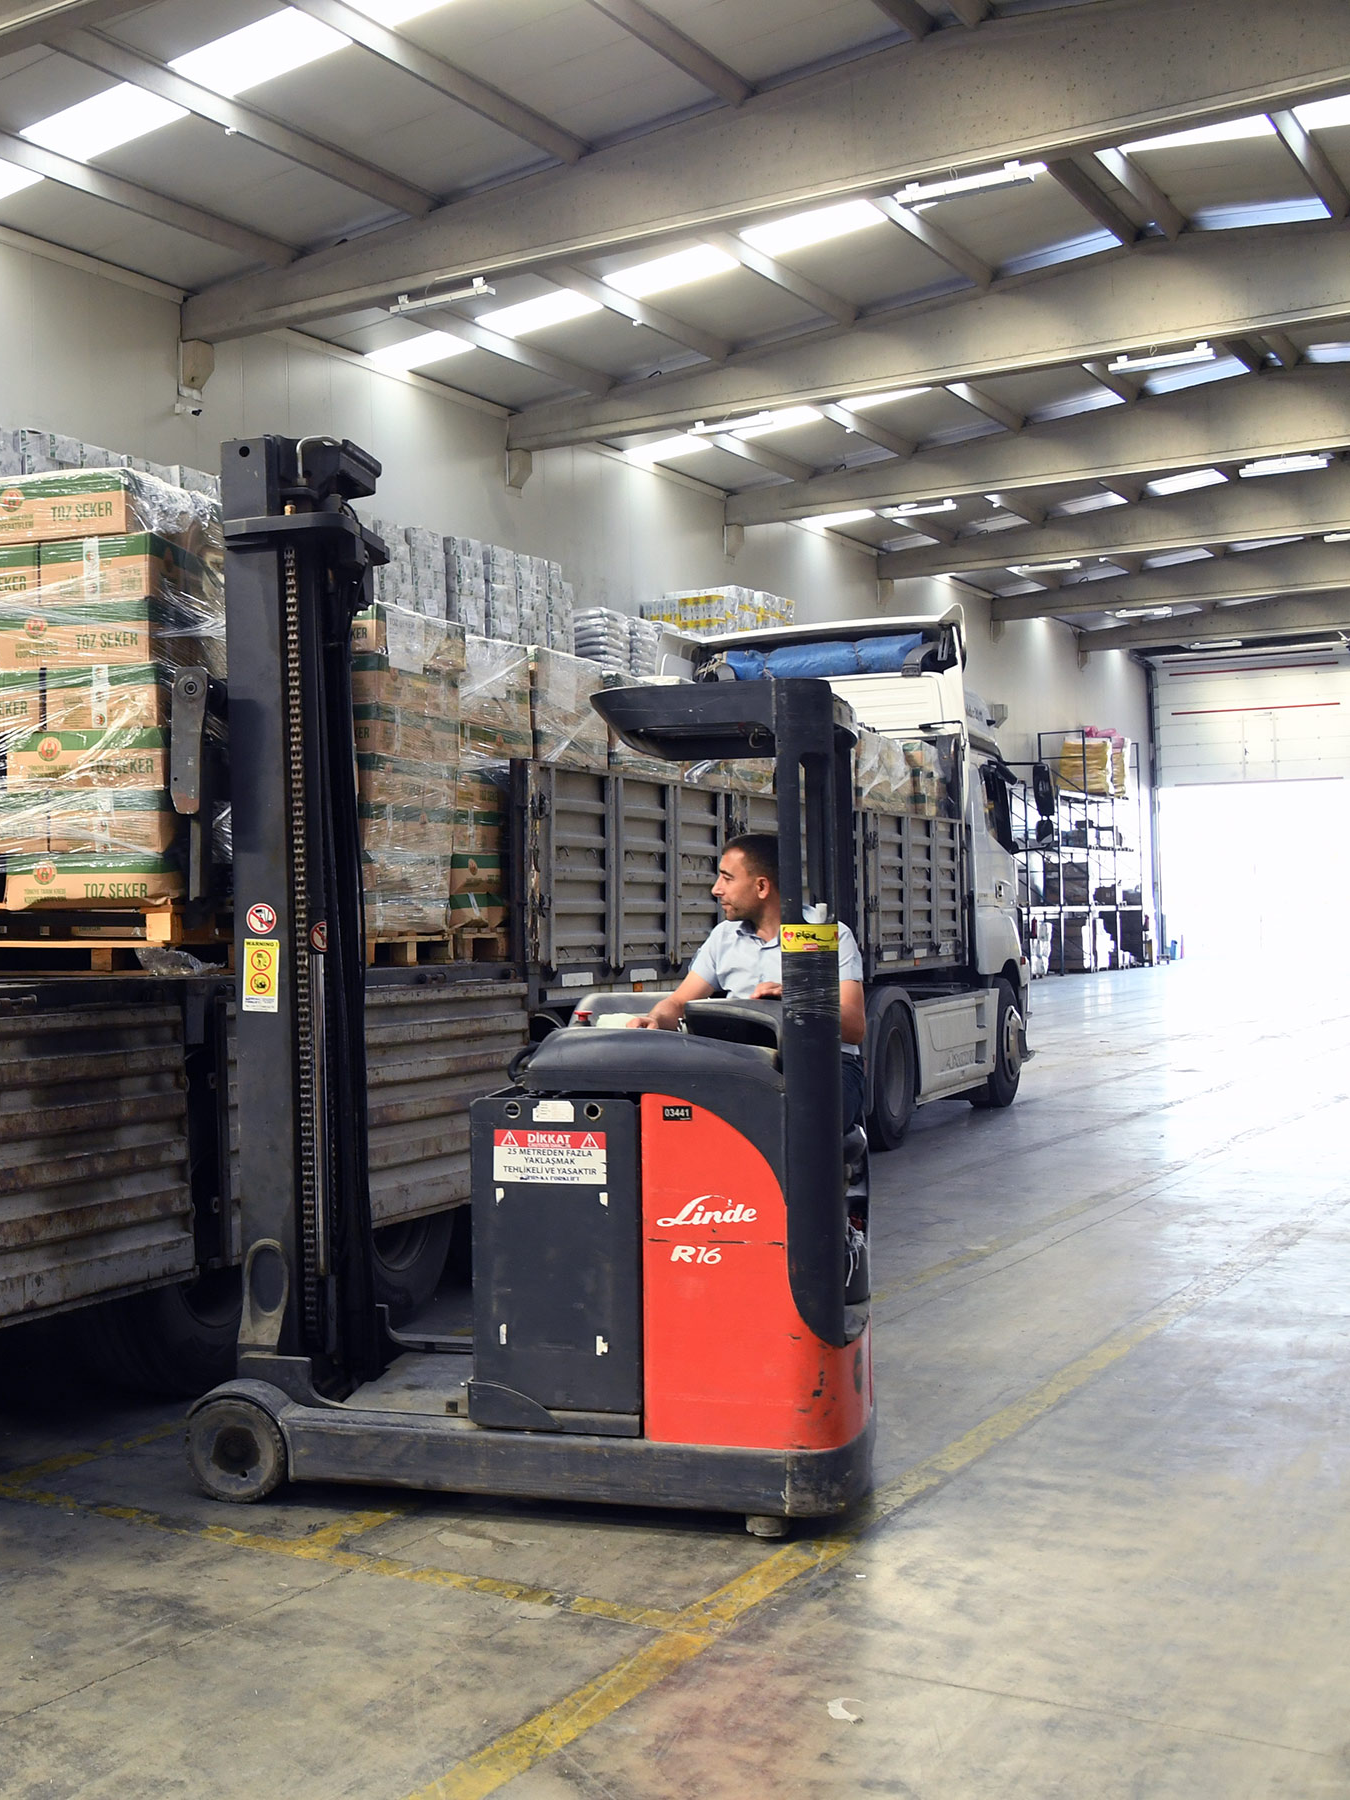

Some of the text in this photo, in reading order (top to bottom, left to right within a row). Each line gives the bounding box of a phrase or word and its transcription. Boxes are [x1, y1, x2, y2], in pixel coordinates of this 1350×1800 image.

[51, 506, 72, 522] TOZ
[75, 501, 112, 523] ŞEKER
[351, 627, 367, 640] KER
[75, 632, 138, 651] TOZ ŞEKER
[84, 883, 106, 899] TOZ
[664, 1108, 689, 1118] 03441
[527, 1132, 571, 1144] DİKKAT
[519, 1148, 564, 1157] METREDEN
[566, 1149, 592, 1157] FAZLA
[524, 1157, 575, 1166] YAKLAŞMAK
[503, 1165, 543, 1174] TEHLİKELİ
[557, 1167, 597, 1175] YASAKTIR
[656, 1194, 758, 1228] Linde
[670, 1245, 723, 1265] R16
